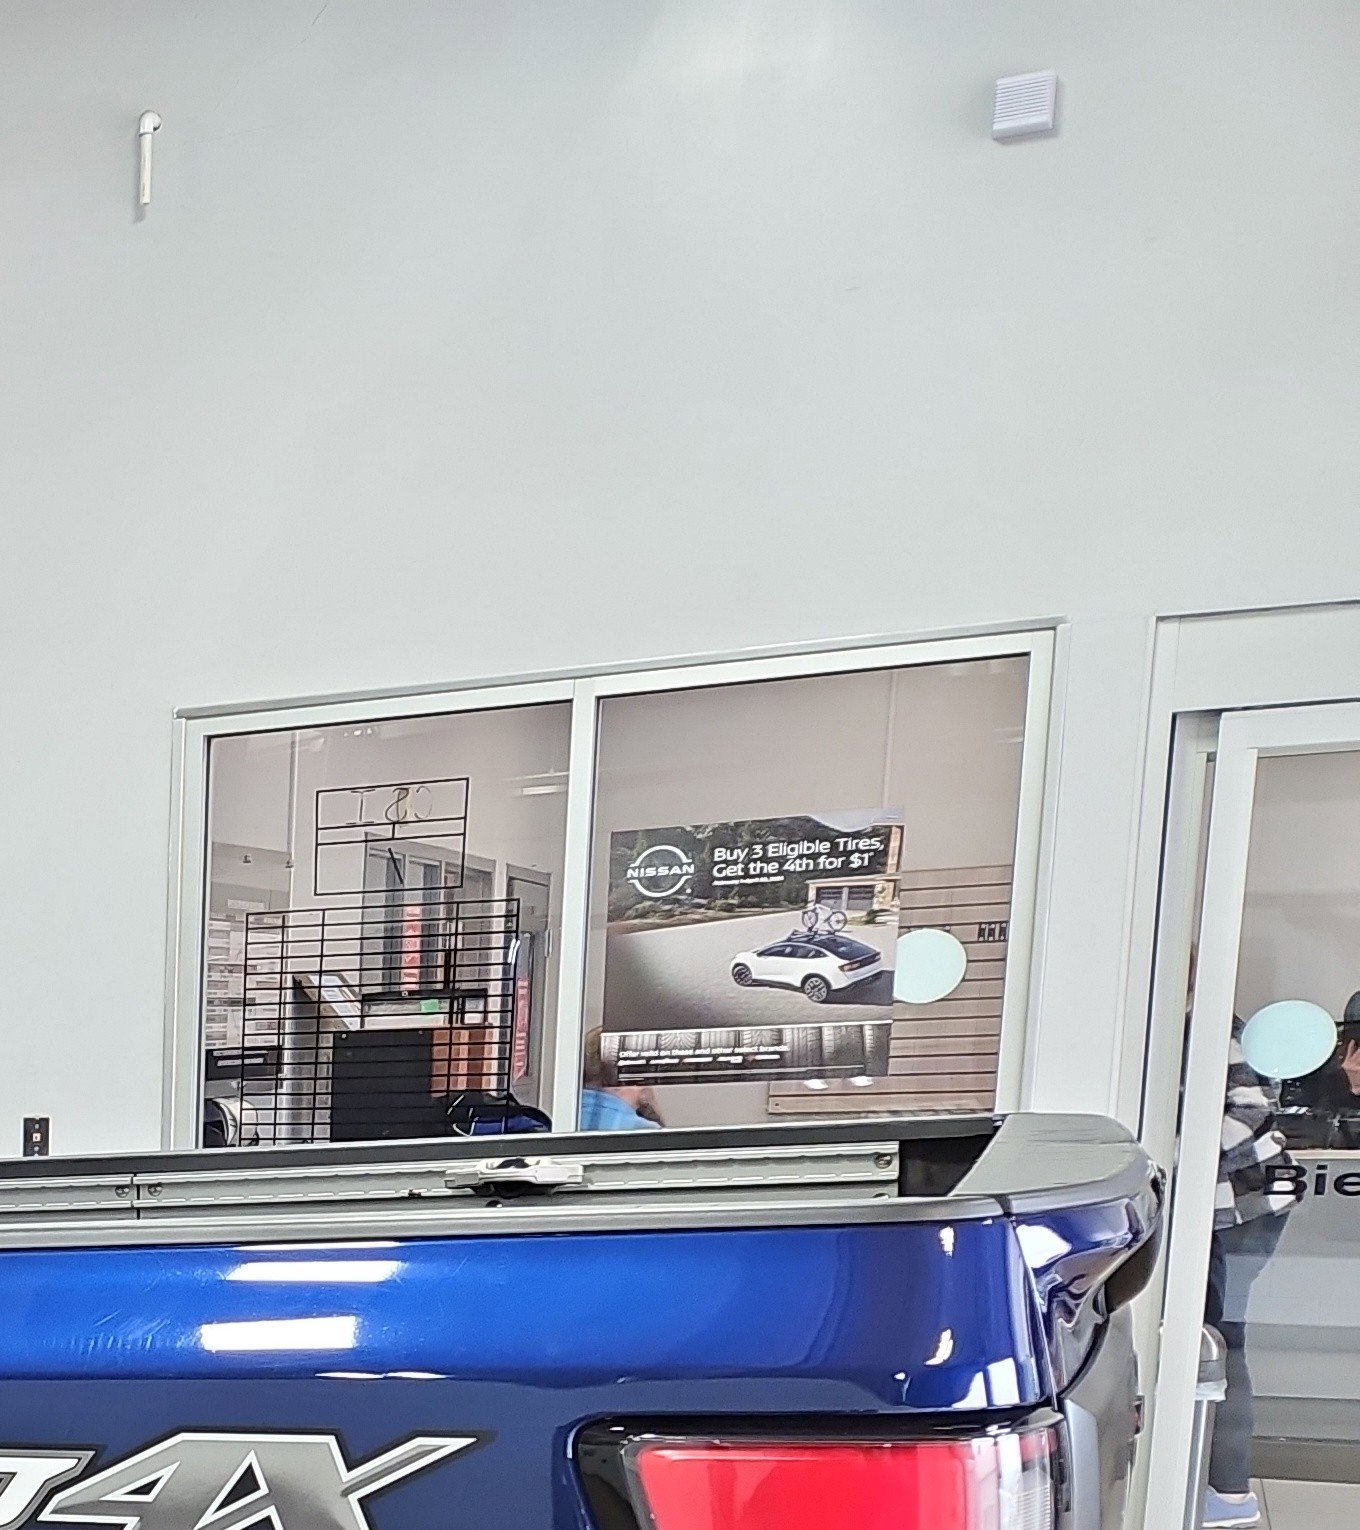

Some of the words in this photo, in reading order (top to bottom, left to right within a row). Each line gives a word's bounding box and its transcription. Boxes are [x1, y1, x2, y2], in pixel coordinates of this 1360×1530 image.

[713, 847, 749, 863] Buy
[751, 844, 764, 859] 3
[767, 840, 831, 859] Eligible
[834, 837, 885, 851] Tires,
[627, 864, 695, 878] NISSAN
[712, 863, 745, 878] Get
[747, 861, 779, 875] the
[782, 857, 814, 871] 4th
[817, 855, 846, 869] for
[1263, 1165, 1360, 1196] Bie
